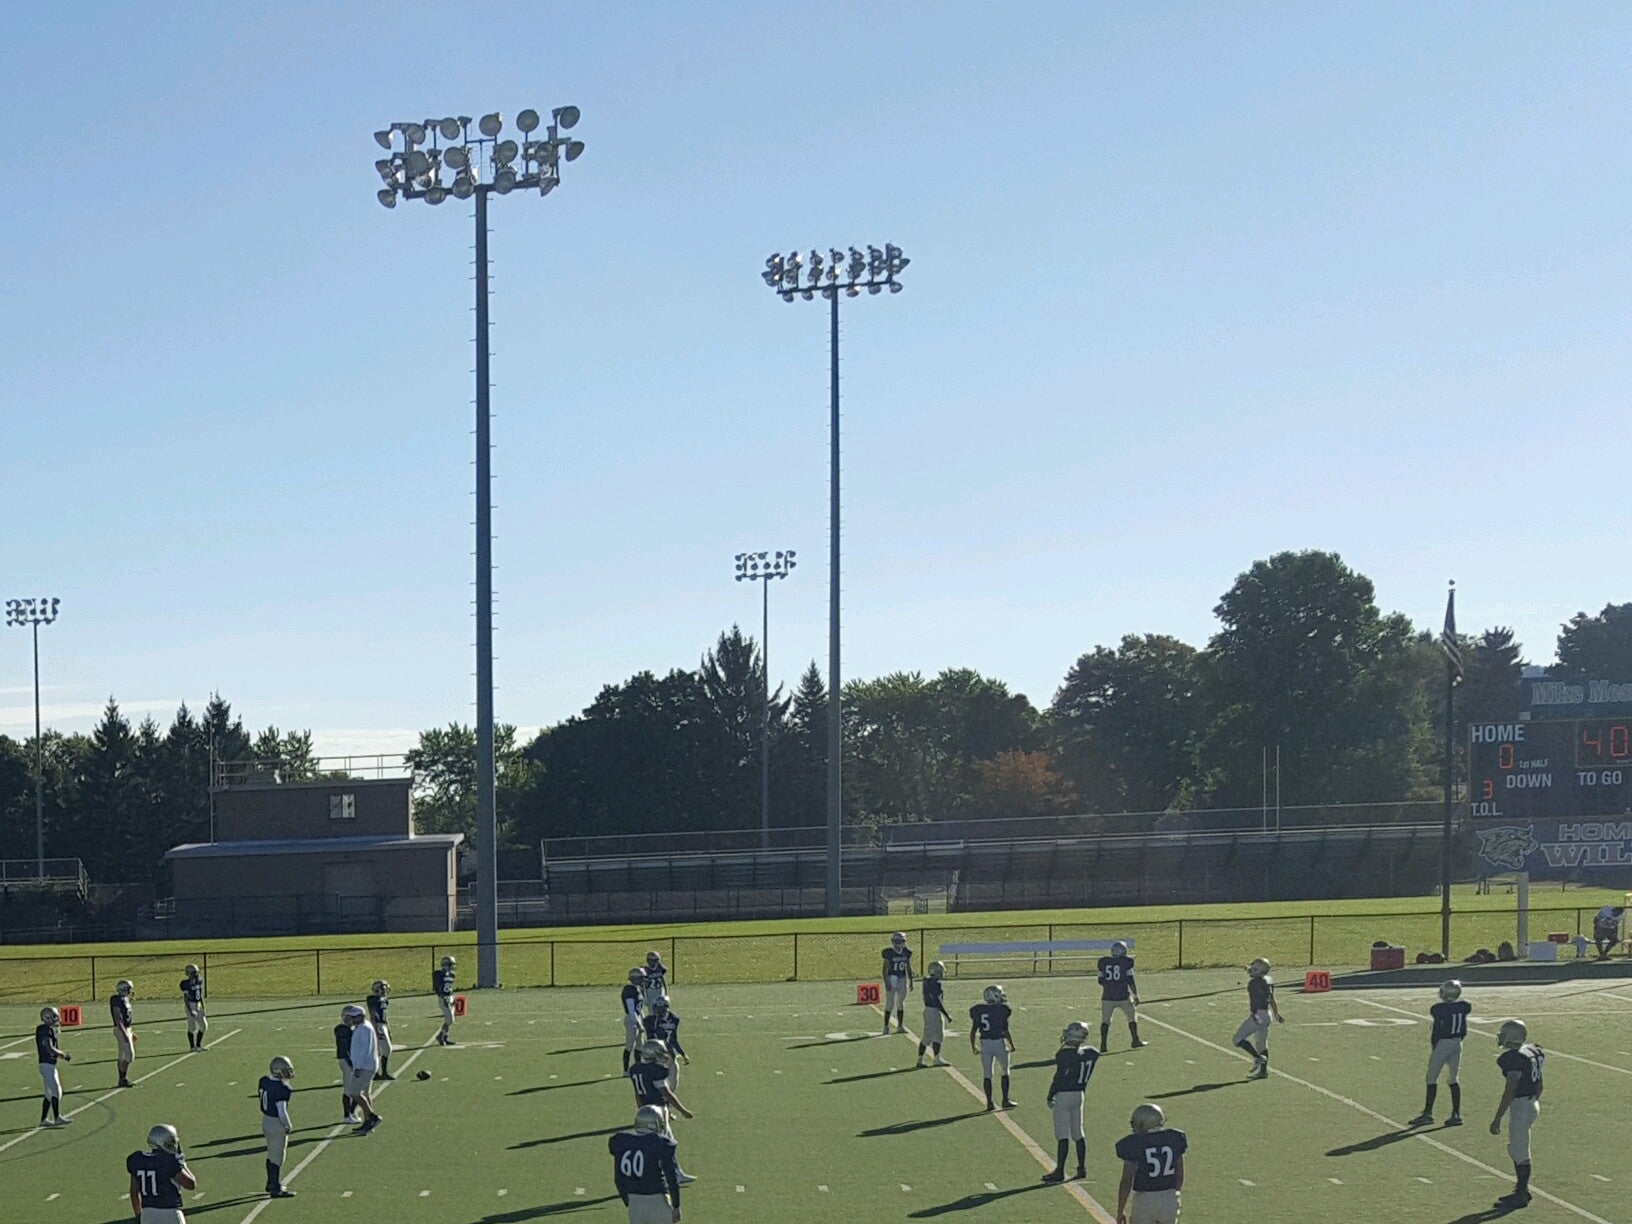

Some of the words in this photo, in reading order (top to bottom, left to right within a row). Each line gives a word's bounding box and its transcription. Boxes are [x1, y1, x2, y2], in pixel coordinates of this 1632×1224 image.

[1531, 680, 1584, 705] Mike
[1471, 724, 1525, 743] HOME
[1583, 725, 1629, 757] 40
[1498, 743, 1515, 769] 0
[1482, 778, 1494, 799] 3
[1506, 773, 1553, 788] DOWN
[1577, 771, 1597, 786] TO
[1601, 770, 1623, 785] GO
[1104, 963, 1121, 981] 58
[1308, 972, 1329, 990] 40
[860, 986, 877, 1002] 30
[61, 1008, 78, 1023] 10
[979, 1012, 991, 1033] 5
[1078, 1059, 1094, 1085] 17
[620, 1149, 645, 1178] 60
[1144, 1145, 1175, 1178] 52
[136, 1169, 159, 1197] 77
